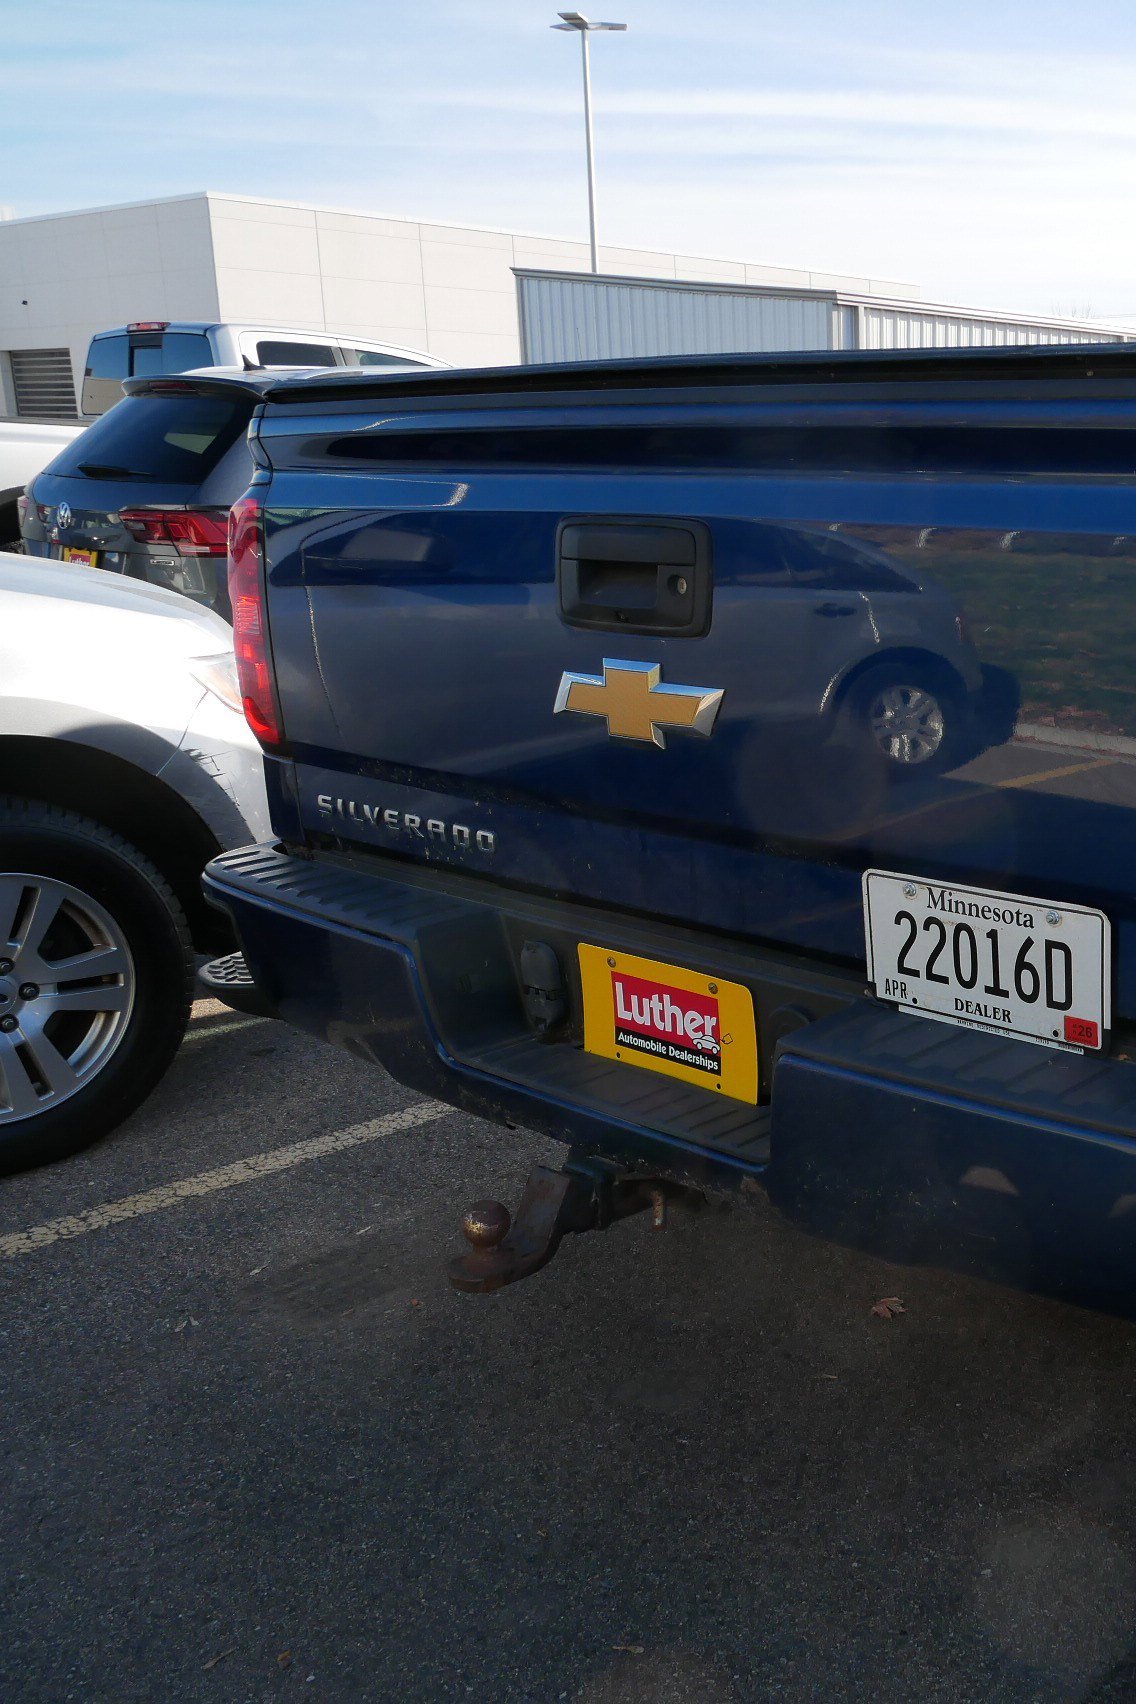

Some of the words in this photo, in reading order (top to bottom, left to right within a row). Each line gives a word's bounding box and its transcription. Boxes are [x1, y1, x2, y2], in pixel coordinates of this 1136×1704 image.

[317, 794, 495, 851] SILVERADO
[926, 887, 1035, 929] Minnesota
[894, 910, 1073, 1011] 22016D
[884, 978, 908, 999] APR
[615, 981, 717, 1040] Luther
[954, 997, 1013, 1024] DEALER
[618, 1031, 667, 1055] Automobile
[668, 1045, 719, 1071] Dealerships
[1078, 1025, 1093, 1038] 26
